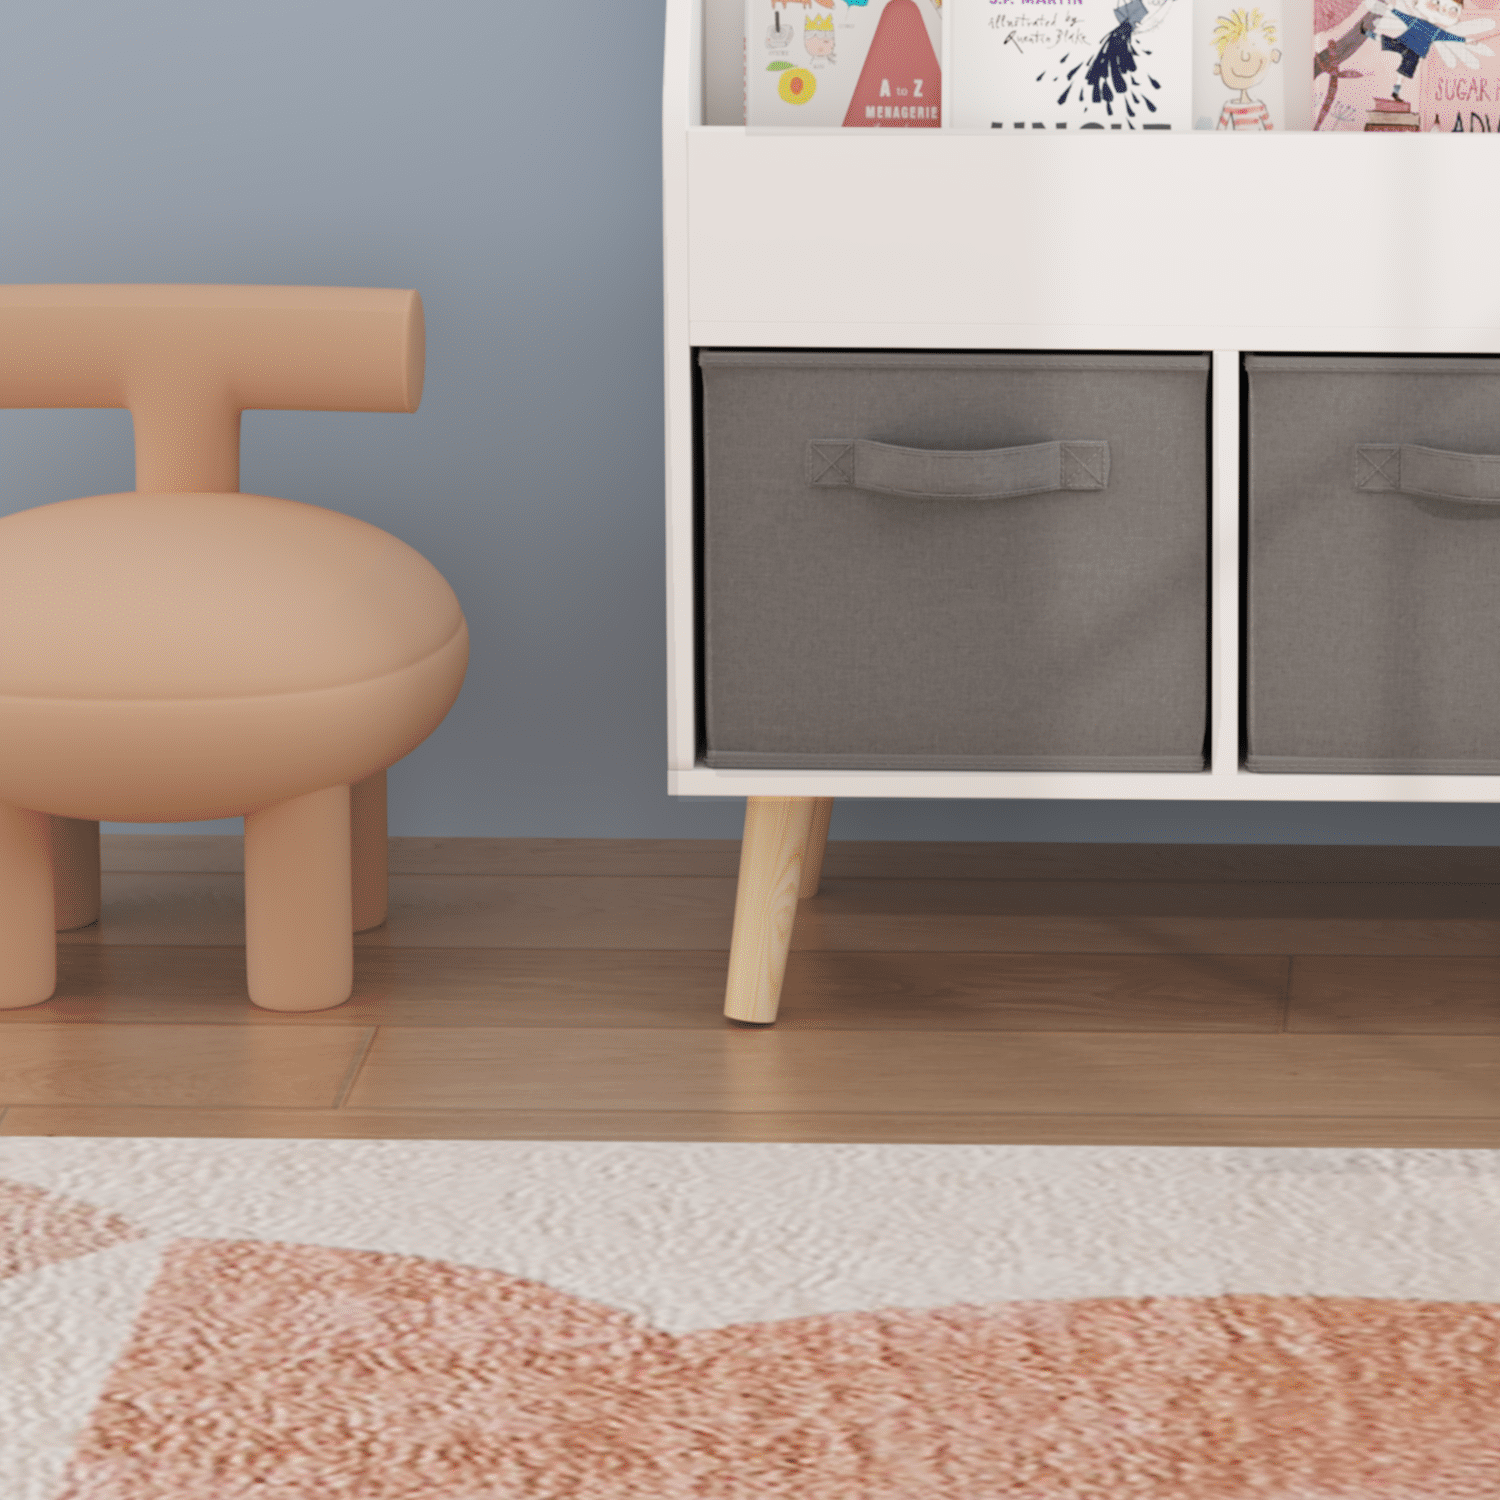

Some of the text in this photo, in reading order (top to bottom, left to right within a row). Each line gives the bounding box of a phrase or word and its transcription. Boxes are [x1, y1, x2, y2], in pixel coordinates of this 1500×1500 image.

[988, 12, 1058, 29] illustrated
[879, 78, 924, 98] A to Z
[1435, 77, 1491, 102] SUGAR
[865, 105, 938, 119] MENAGERIE
